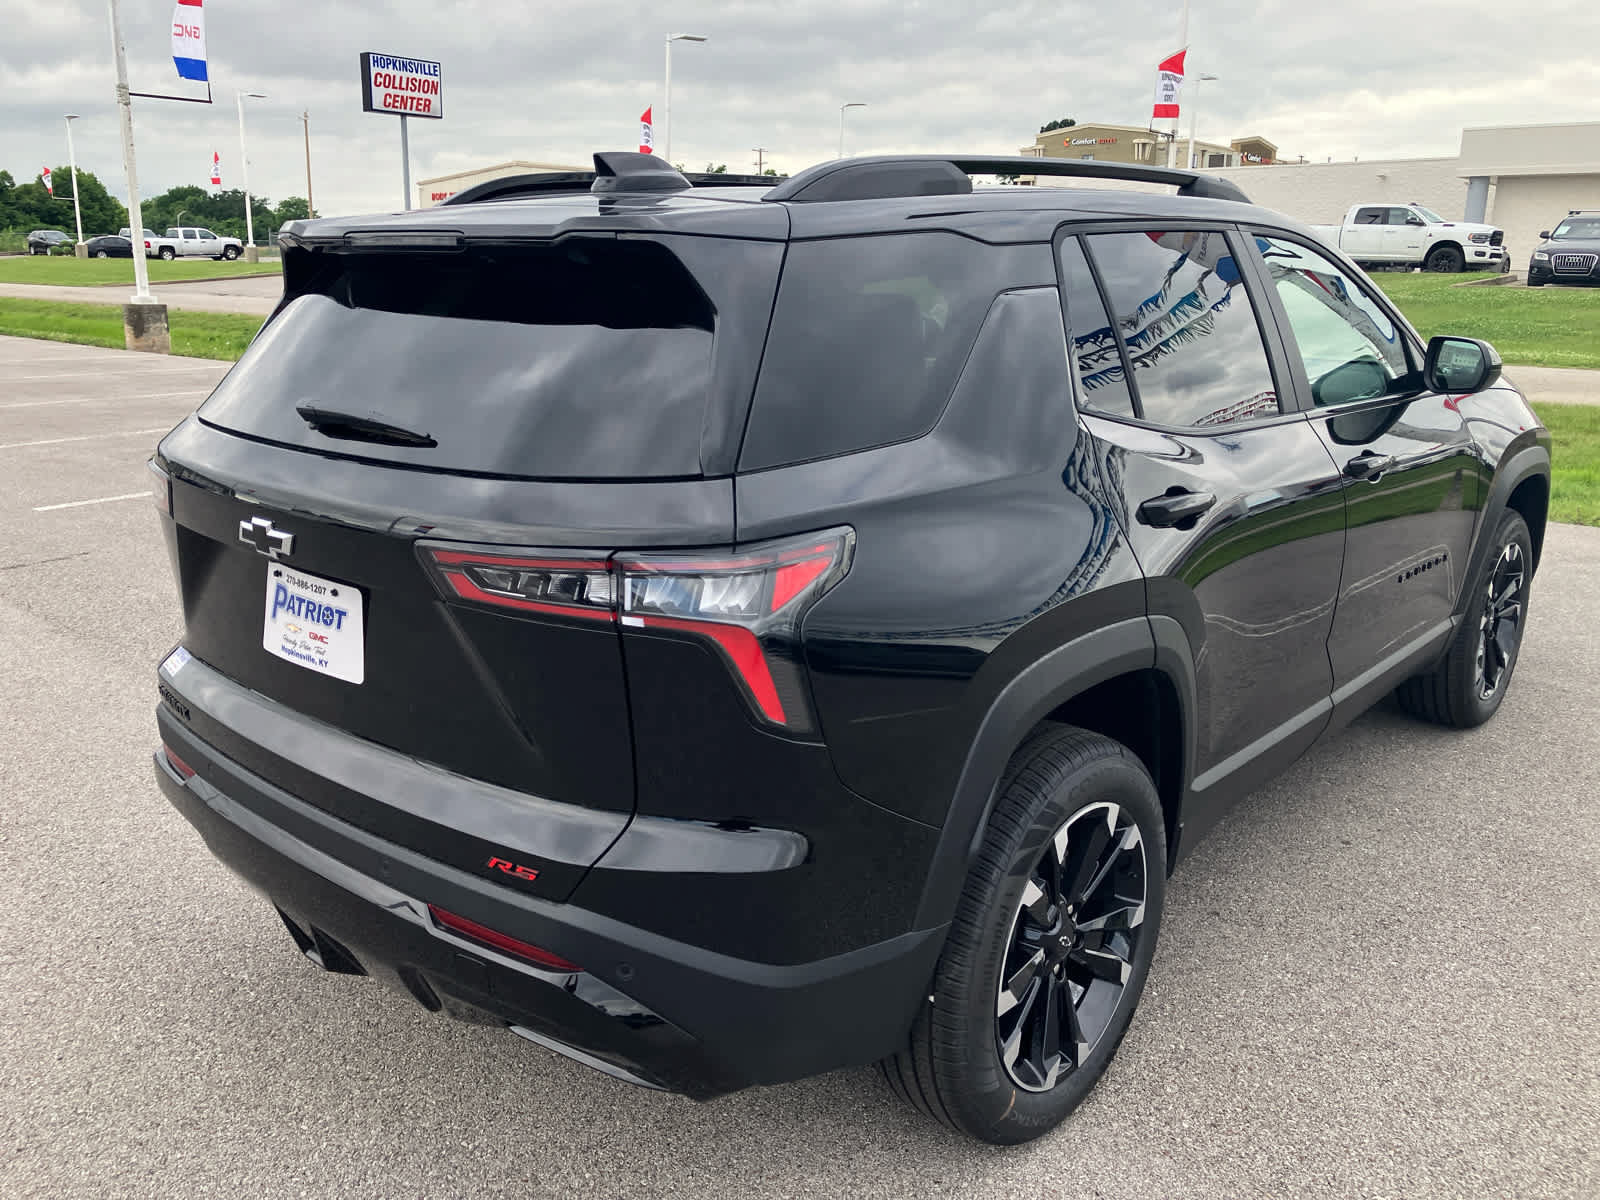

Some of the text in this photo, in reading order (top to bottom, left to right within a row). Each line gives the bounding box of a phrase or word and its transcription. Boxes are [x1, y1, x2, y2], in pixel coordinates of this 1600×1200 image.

[372, 55, 438, 77] HOPKINSVILLE
[373, 72, 439, 95] COLLISION
[383, 92, 432, 113] CENTER
[1071, 137, 1097, 145] Comfort
[272, 582, 347, 630] PATRIOT
[308, 631, 329, 645] GMC
[318, 658, 329, 668] KY
[487, 857, 540, 880] RS
